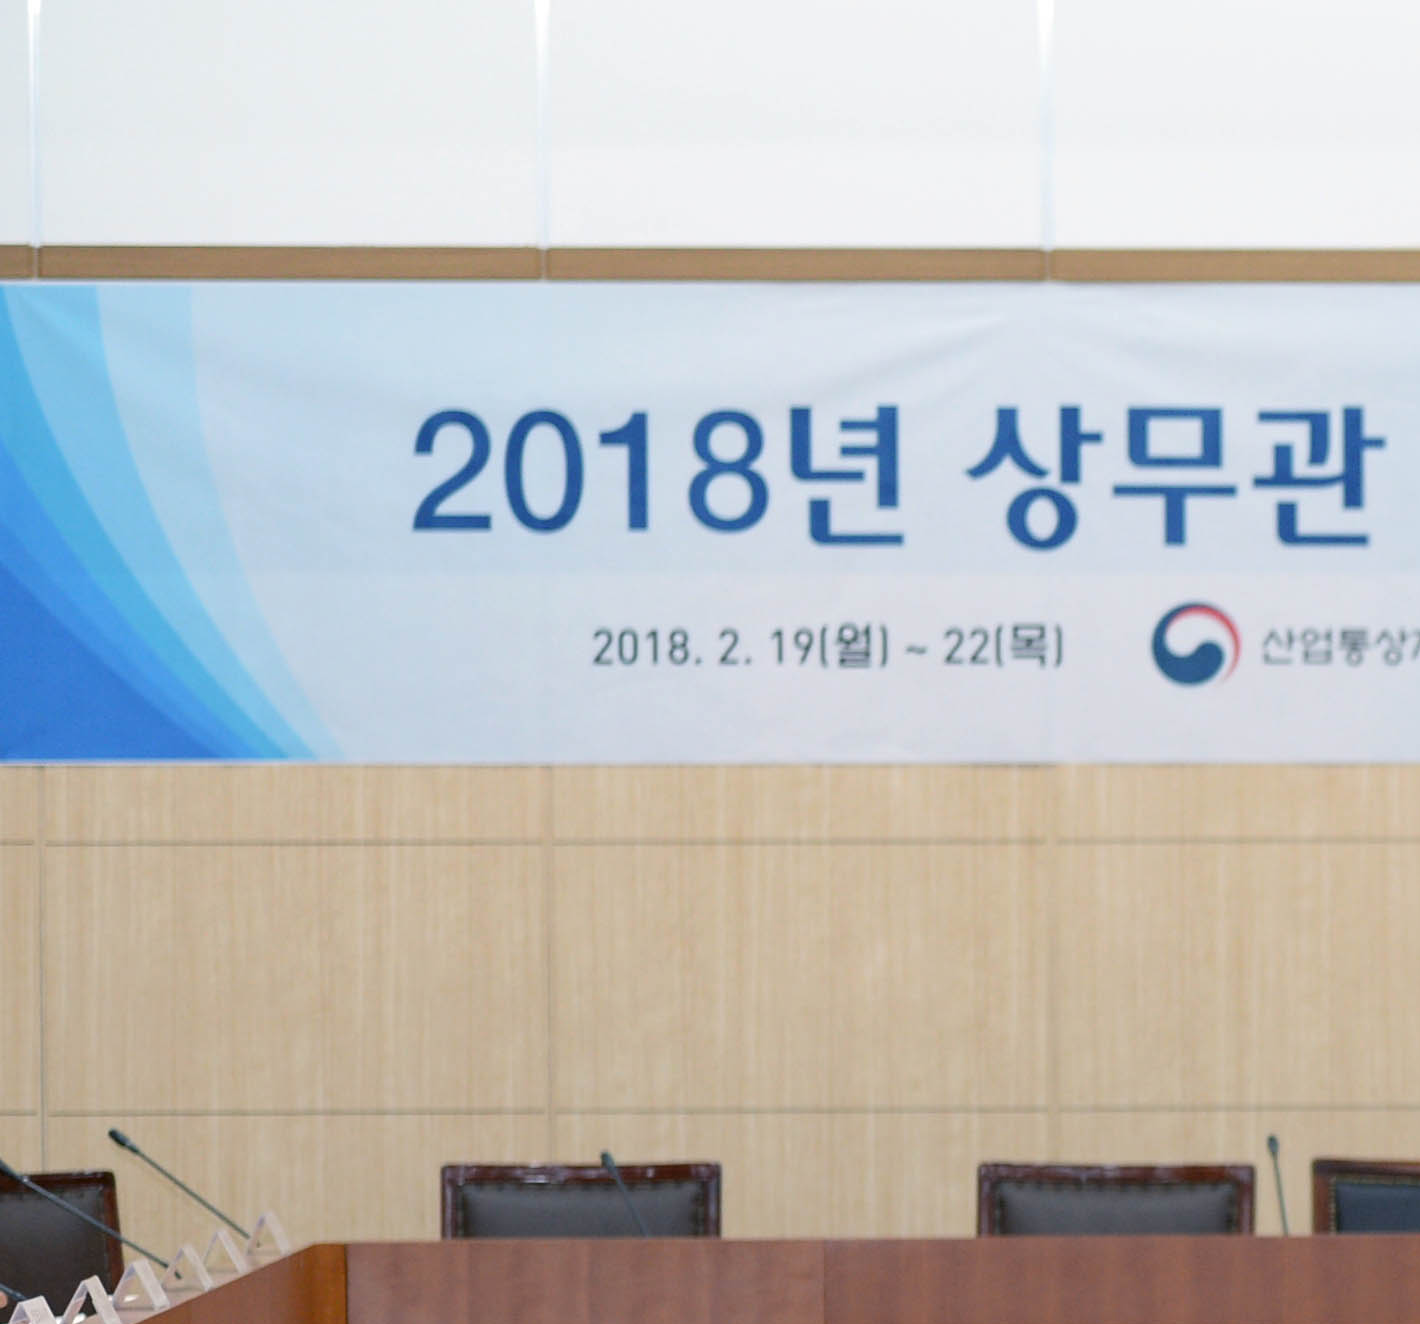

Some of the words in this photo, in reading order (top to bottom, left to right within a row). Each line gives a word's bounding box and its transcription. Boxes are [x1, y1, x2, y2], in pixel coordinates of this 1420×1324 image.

[412, 405, 906, 548] 2018년
[965, 404, 1387, 553] 상무관
[591, 627, 704, 667] 2018.
[718, 627, 753, 667] 2.
[770, 622, 890, 670] 19(월)
[942, 622, 1064, 668] 22(목)
